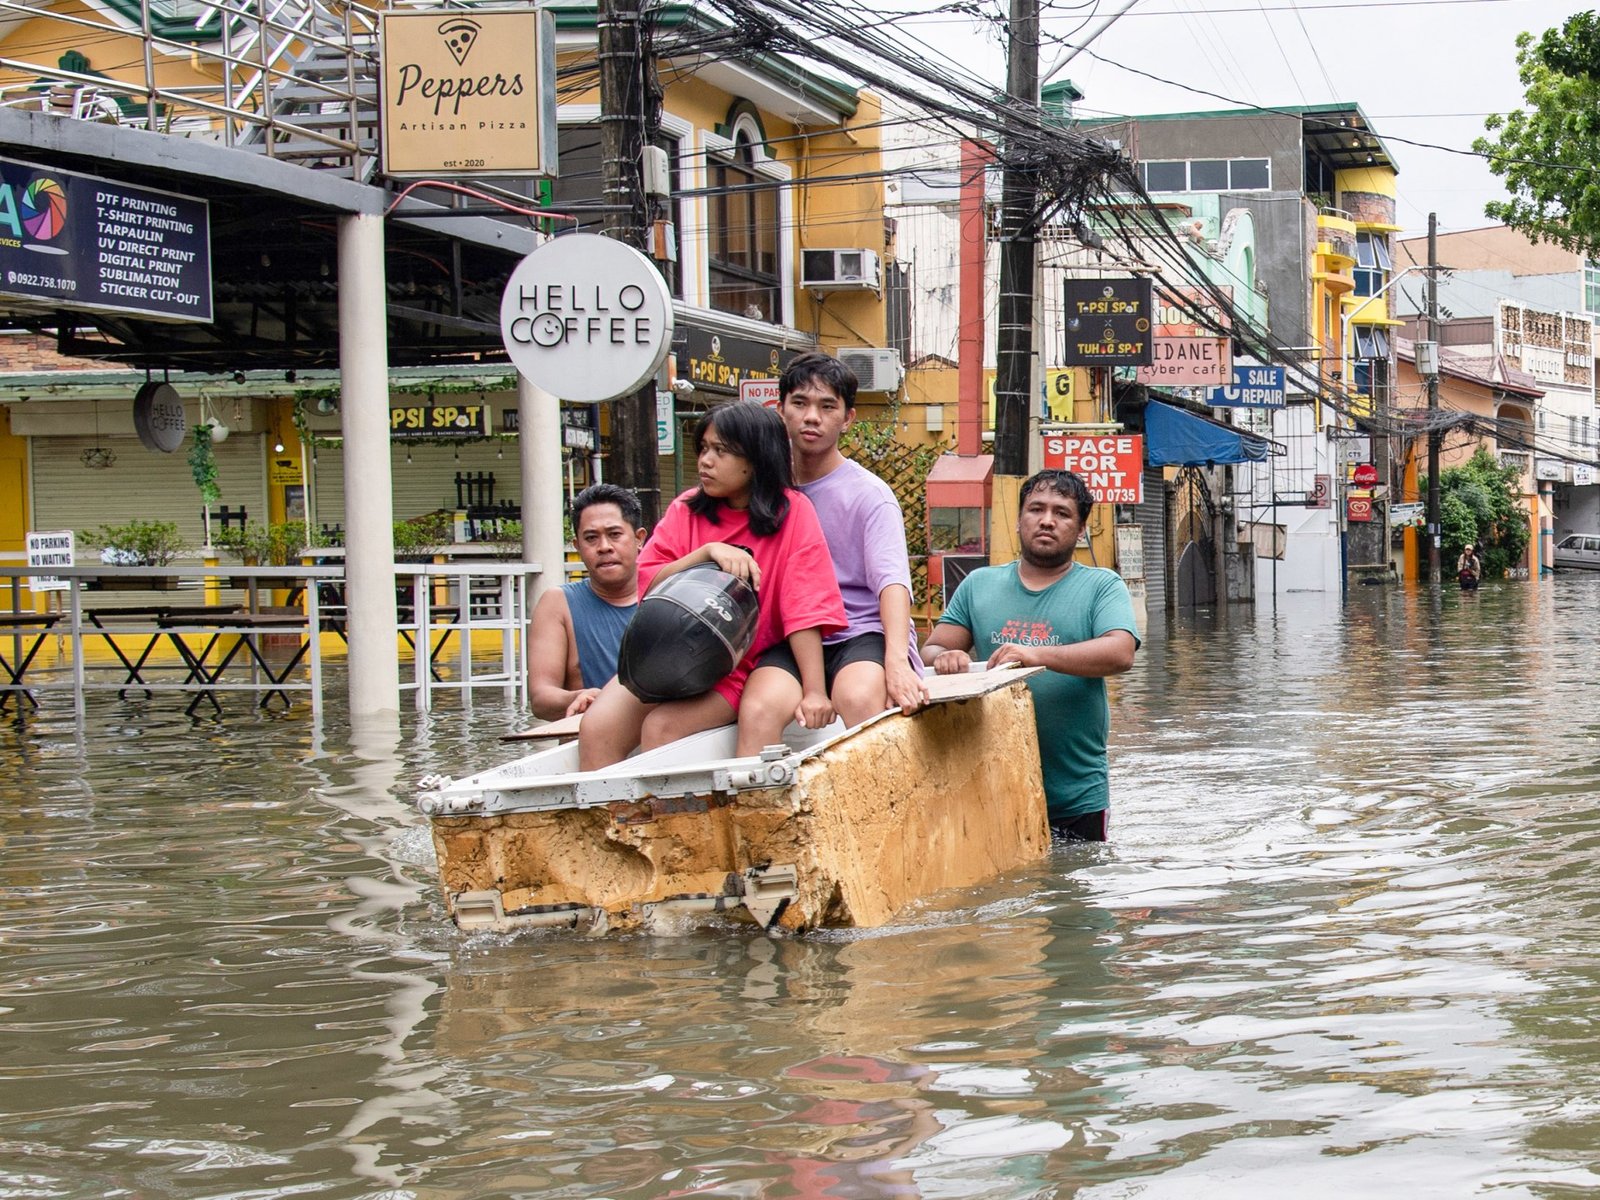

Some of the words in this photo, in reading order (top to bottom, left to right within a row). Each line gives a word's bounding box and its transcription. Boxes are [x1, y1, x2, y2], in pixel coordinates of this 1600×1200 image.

[397, 63, 524, 116] Peppers
[400, 122, 467, 131] Artisan
[479, 121, 526, 130] Pizza
[443, 160, 457, 168] est
[464, 159, 485, 167] 2020
[96, 191, 120, 206] DTF
[121, 197, 177, 217] PRINTING
[97, 207, 144, 225] T-SHIRT
[145, 216, 194, 235] PRINTING
[97, 222, 164, 243] TARPAULIN
[98, 237, 116, 249] UV
[118, 241, 160, 256] DIRECT
[161, 248, 196, 263] PRINT
[99, 252, 146, 270] DIGITAL
[148, 260, 183, 275] PRINT
[17, 273, 77, 291] 0922.758.1070
[99, 267, 180, 289] SUBLIMATION
[100, 282, 148, 299] STICKER
[150, 289, 200, 306] CUT-OUT
[519, 284, 645, 312] HELLO
[511, 312, 650, 348] COFFEE
[1142, 364, 1185, 376] cyber
[1192, 363, 1227, 375] café
[1248, 370, 1277, 386] SALE
[748, 387, 761, 397] NO
[764, 387, 780, 397] PAR
[1242, 389, 1283, 405] REPAIR
[153, 404, 183, 418] HELLO
[392, 408, 425, 429] PSI
[152, 416, 185, 432] COFFEE
[1048, 439, 1133, 454] SPACE
[1064, 456, 1117, 471] FOR
[1076, 472, 1127, 488] ENT
[1106, 489, 1135, 502] 0735
[30, 538, 40, 550] NO
[40, 536, 70, 549] PARKING
[31, 554, 41, 566] NO
[41, 553, 71, 566] WAITING
[704, 597, 733, 621] EVO
